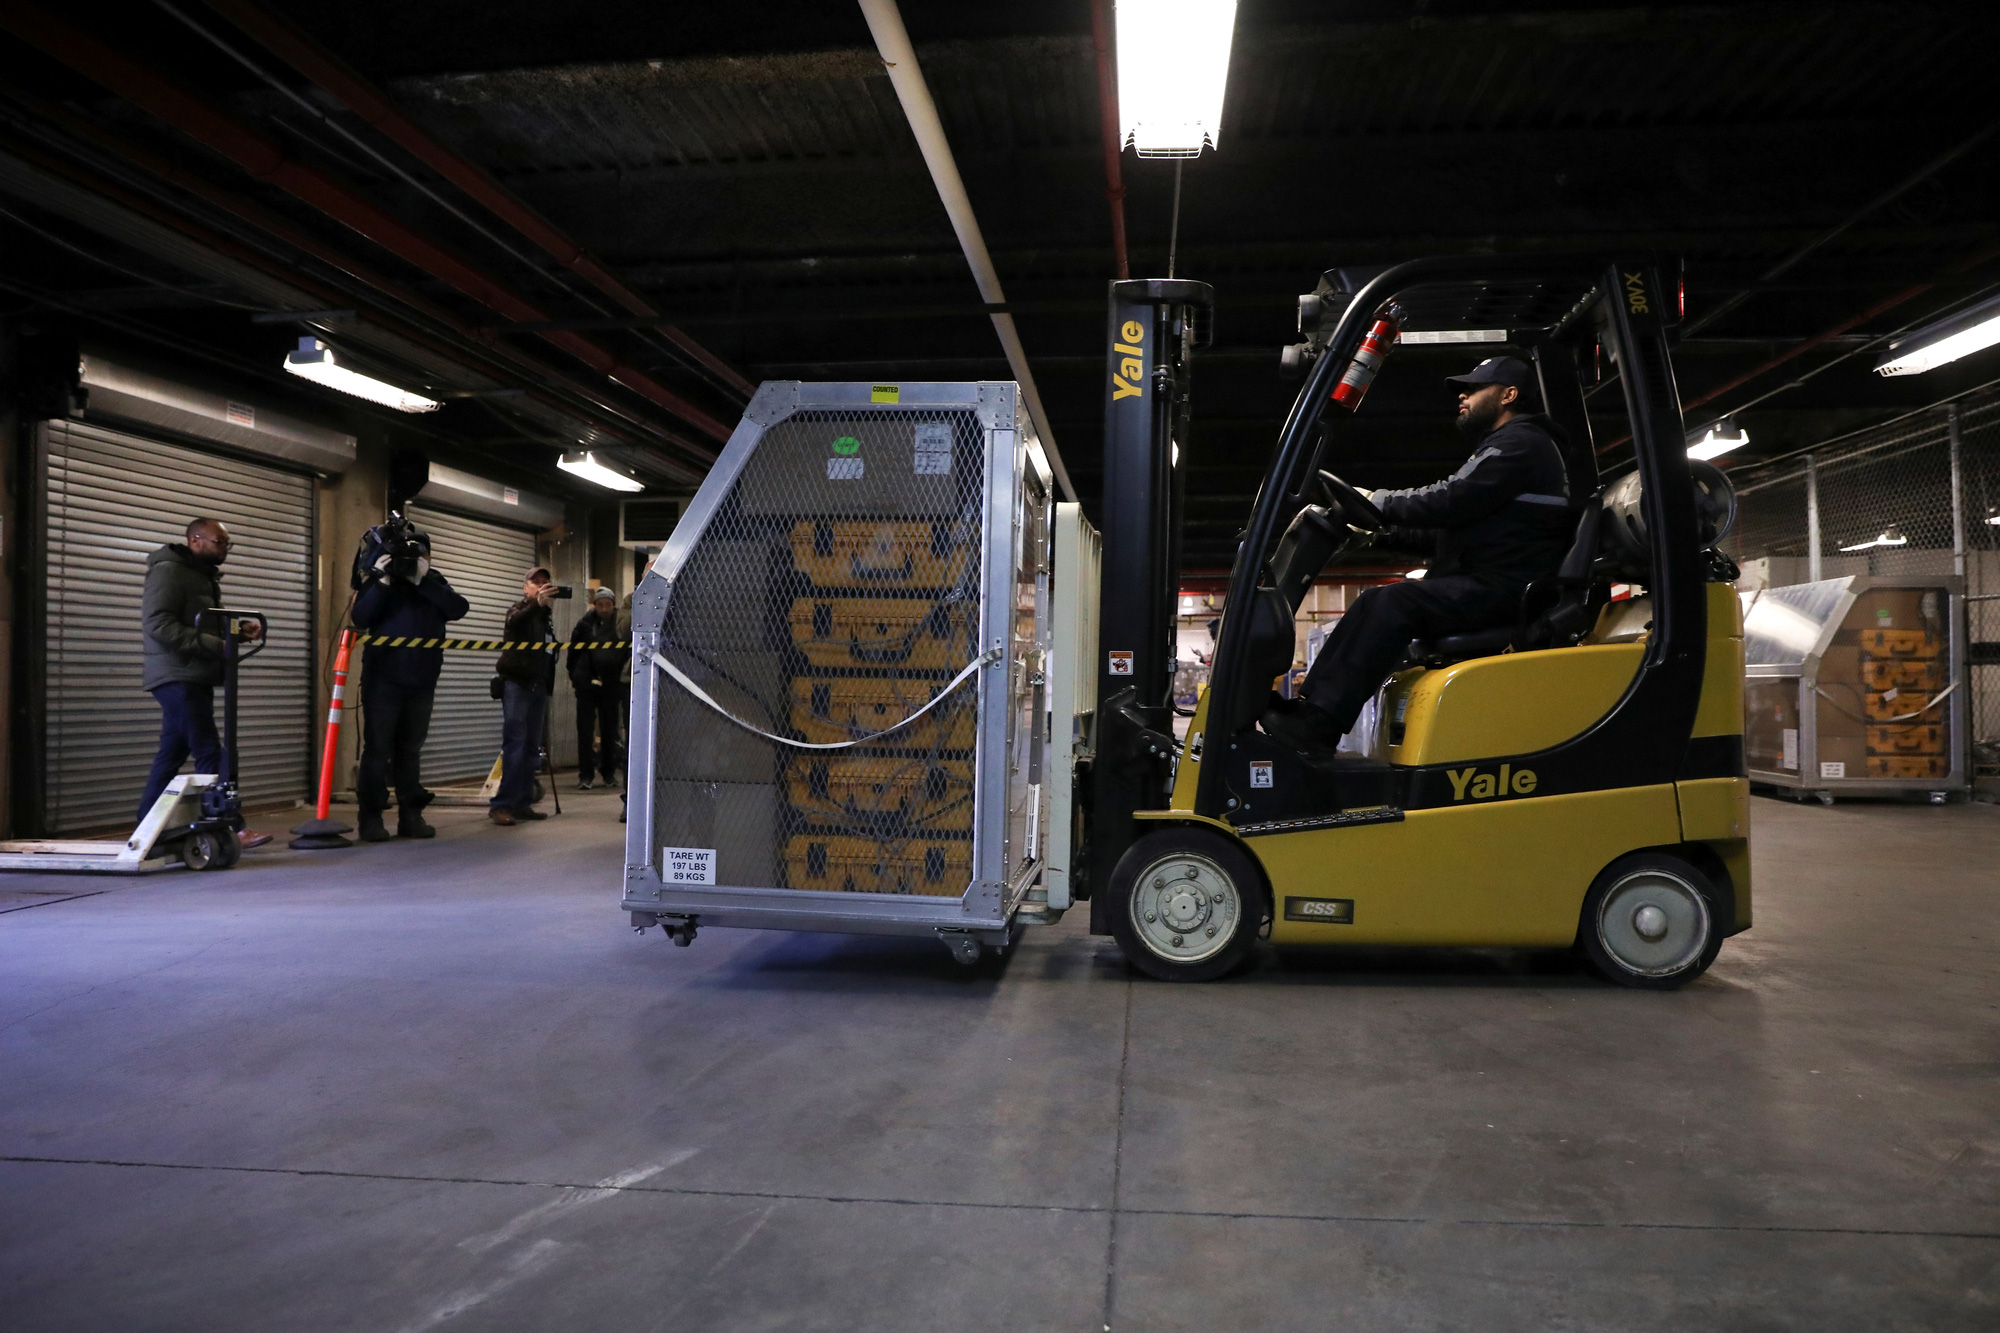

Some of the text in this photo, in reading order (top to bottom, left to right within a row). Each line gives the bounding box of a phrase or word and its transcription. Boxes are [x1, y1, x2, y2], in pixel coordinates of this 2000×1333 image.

[1624, 272, 1649, 314] 30VX
[1113, 320, 1144, 401] Yale
[1445, 763, 1538, 801] Yale
[670, 851, 710, 861] TARE WT
[672, 862, 707, 871] 197 LBS
[673, 872, 705, 881] 89 KGS
[1303, 902, 1337, 915] CSS
